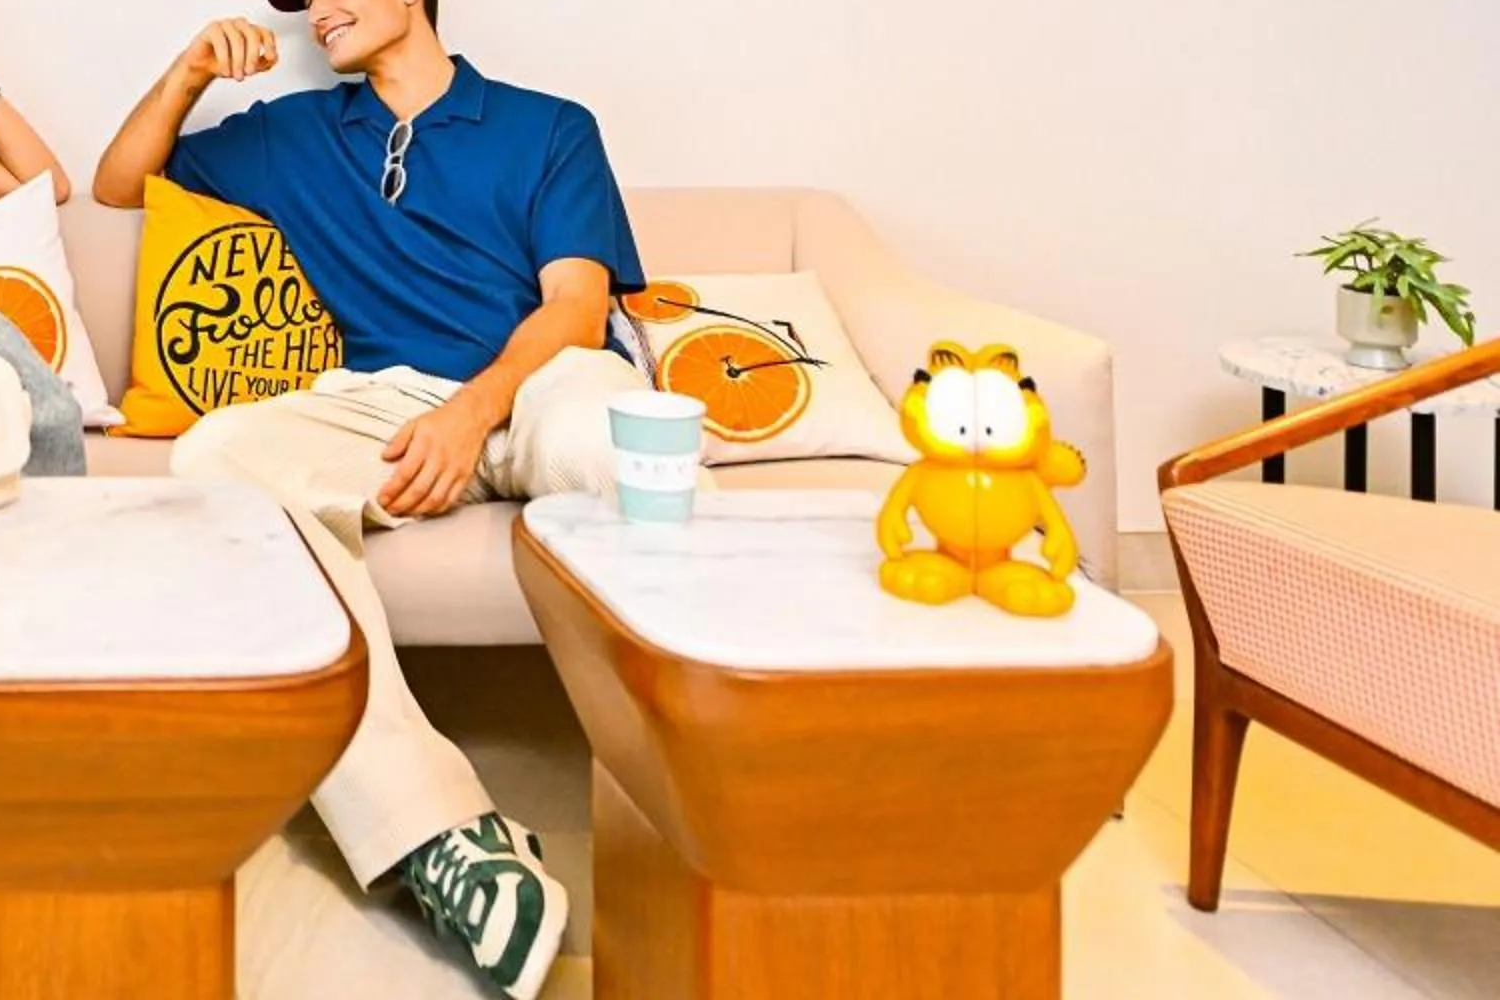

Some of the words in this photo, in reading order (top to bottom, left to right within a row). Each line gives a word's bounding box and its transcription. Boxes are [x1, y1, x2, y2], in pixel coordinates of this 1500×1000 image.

[188, 231, 295, 285] NEVE
[157, 276, 325, 365] Follo
[226, 337, 275, 369] THE
[282, 322, 340, 373] HER
[188, 367, 242, 408] LIVE
[245, 375, 289, 397] YOUR
